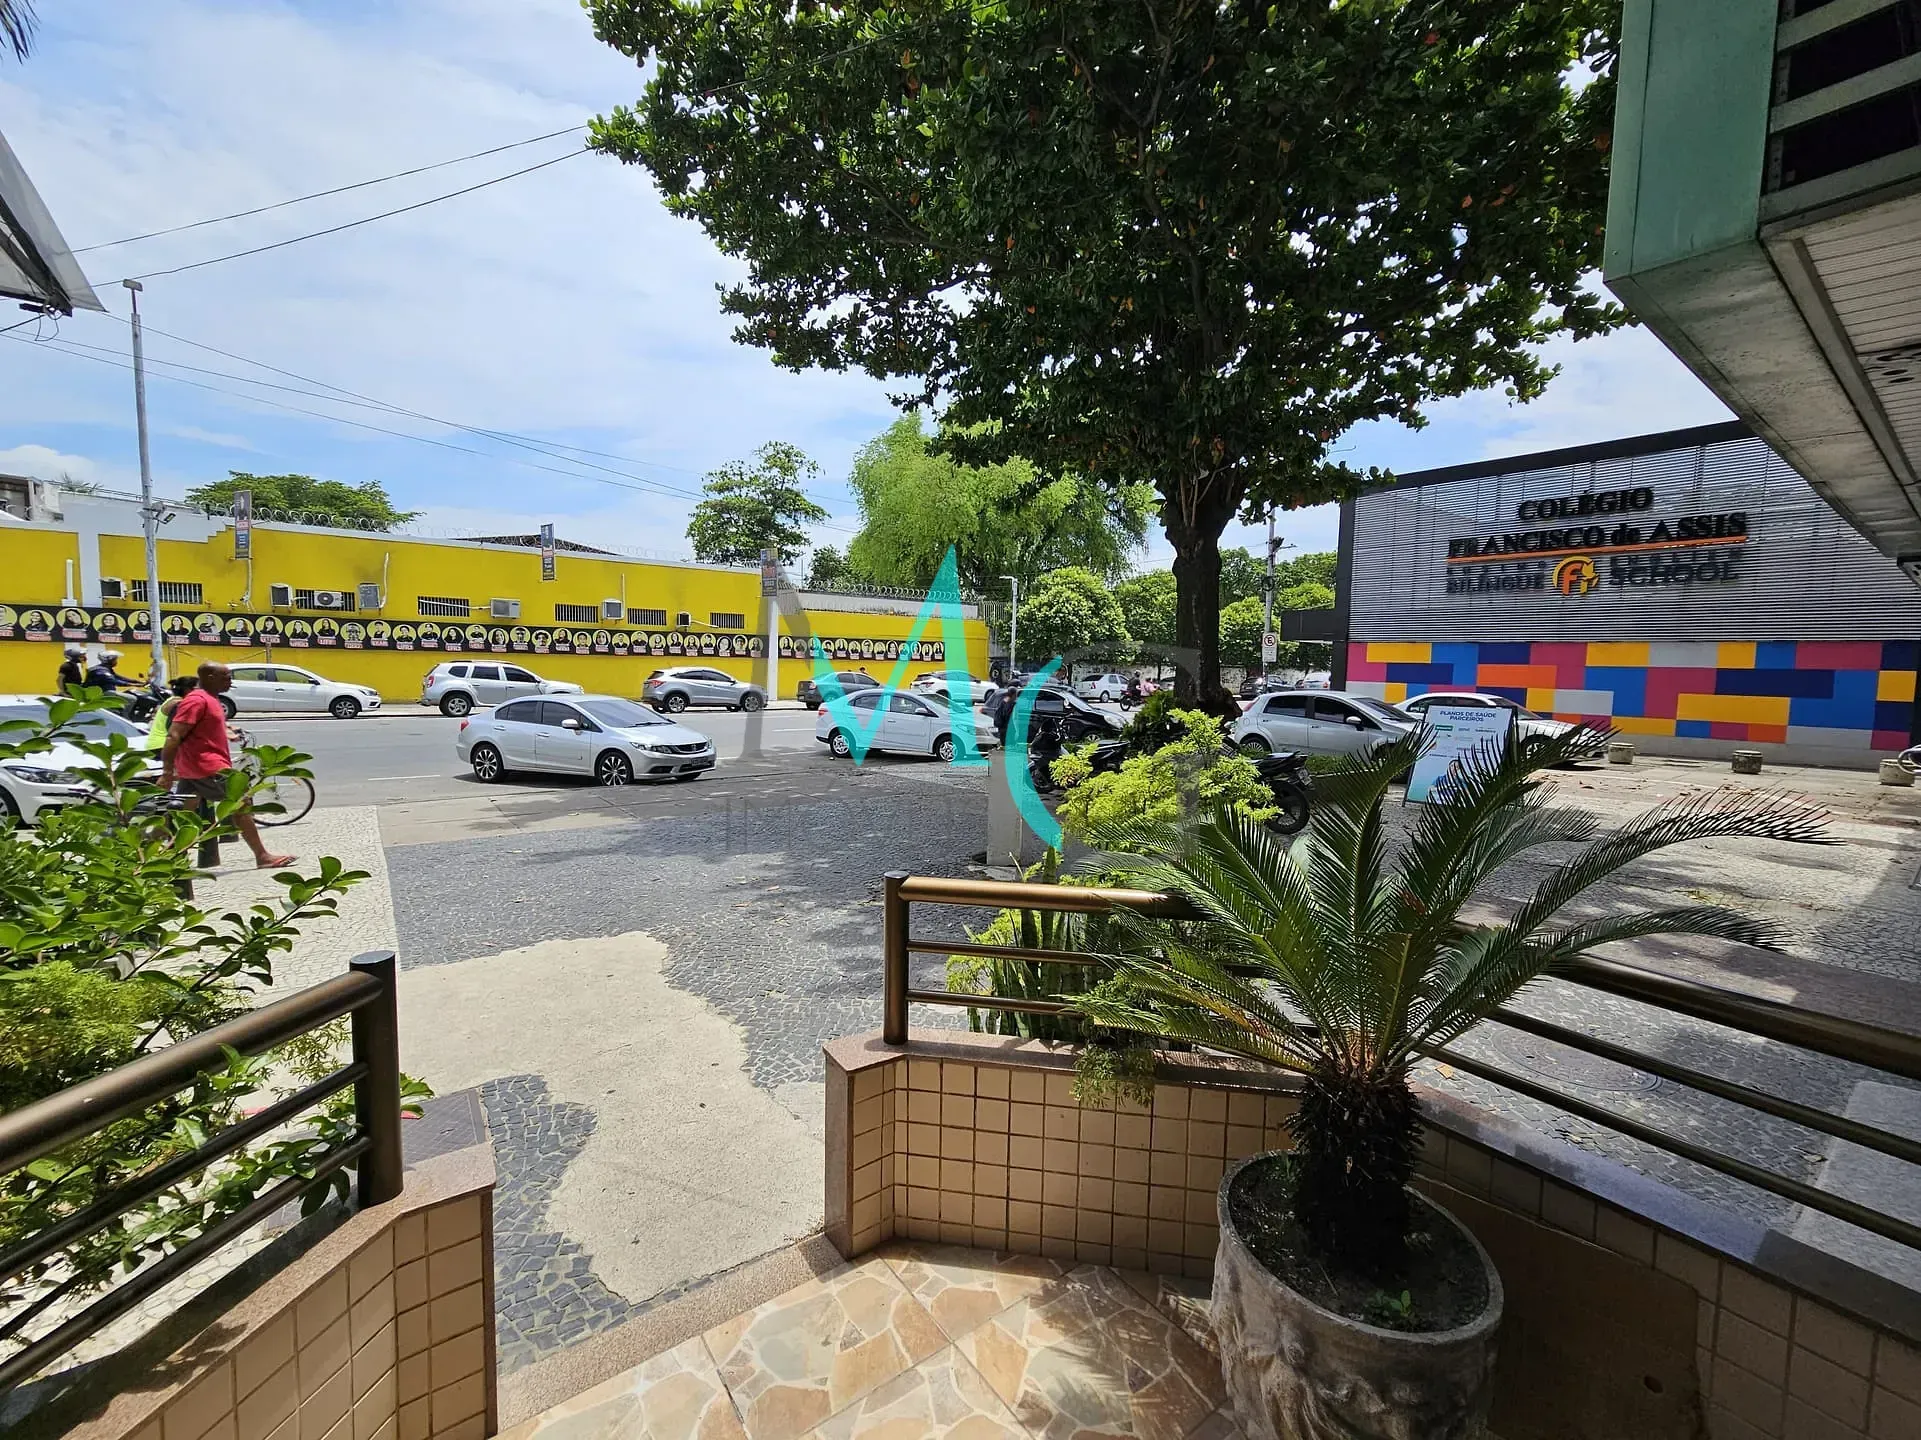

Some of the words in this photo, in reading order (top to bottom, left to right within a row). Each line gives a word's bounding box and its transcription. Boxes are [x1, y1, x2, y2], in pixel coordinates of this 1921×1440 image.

[1518, 487, 1654, 521] COLÉGIO
[1447, 525, 1606, 559] FRANCISCO
[1611, 523, 1641, 546] de
[1646, 511, 1747, 543] ASSIS
[1609, 562, 1740, 586] SCHOOL
